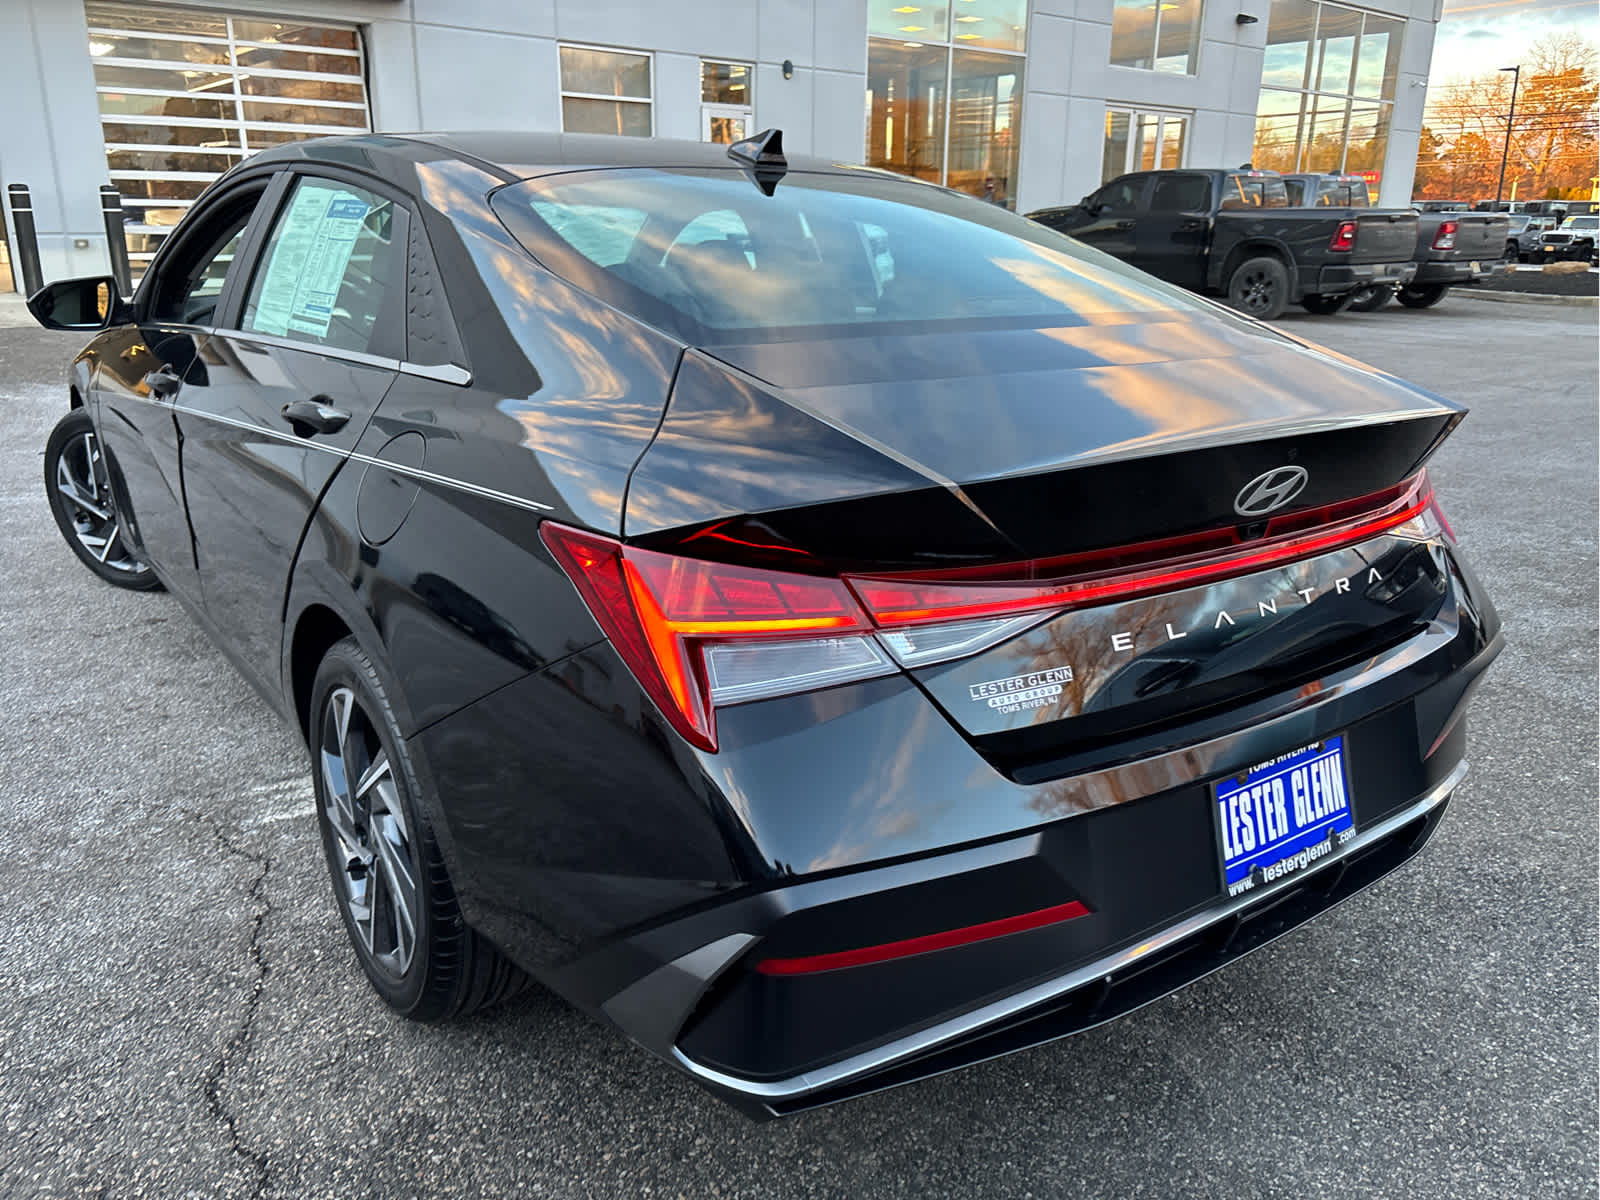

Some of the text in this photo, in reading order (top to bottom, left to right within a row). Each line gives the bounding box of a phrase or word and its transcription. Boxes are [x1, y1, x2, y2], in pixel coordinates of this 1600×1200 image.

[1111, 567, 1383, 652] ELANTRA
[969, 668, 1073, 698] LESTER GLENN
[991, 685, 1060, 706] AUTO GROUP
[997, 704, 1021, 715] TOMS
[1049, 696, 1058, 705] NJ
[1219, 752, 1347, 861] LESTER GLENN
[1262, 840, 1332, 883] lesterglenn
